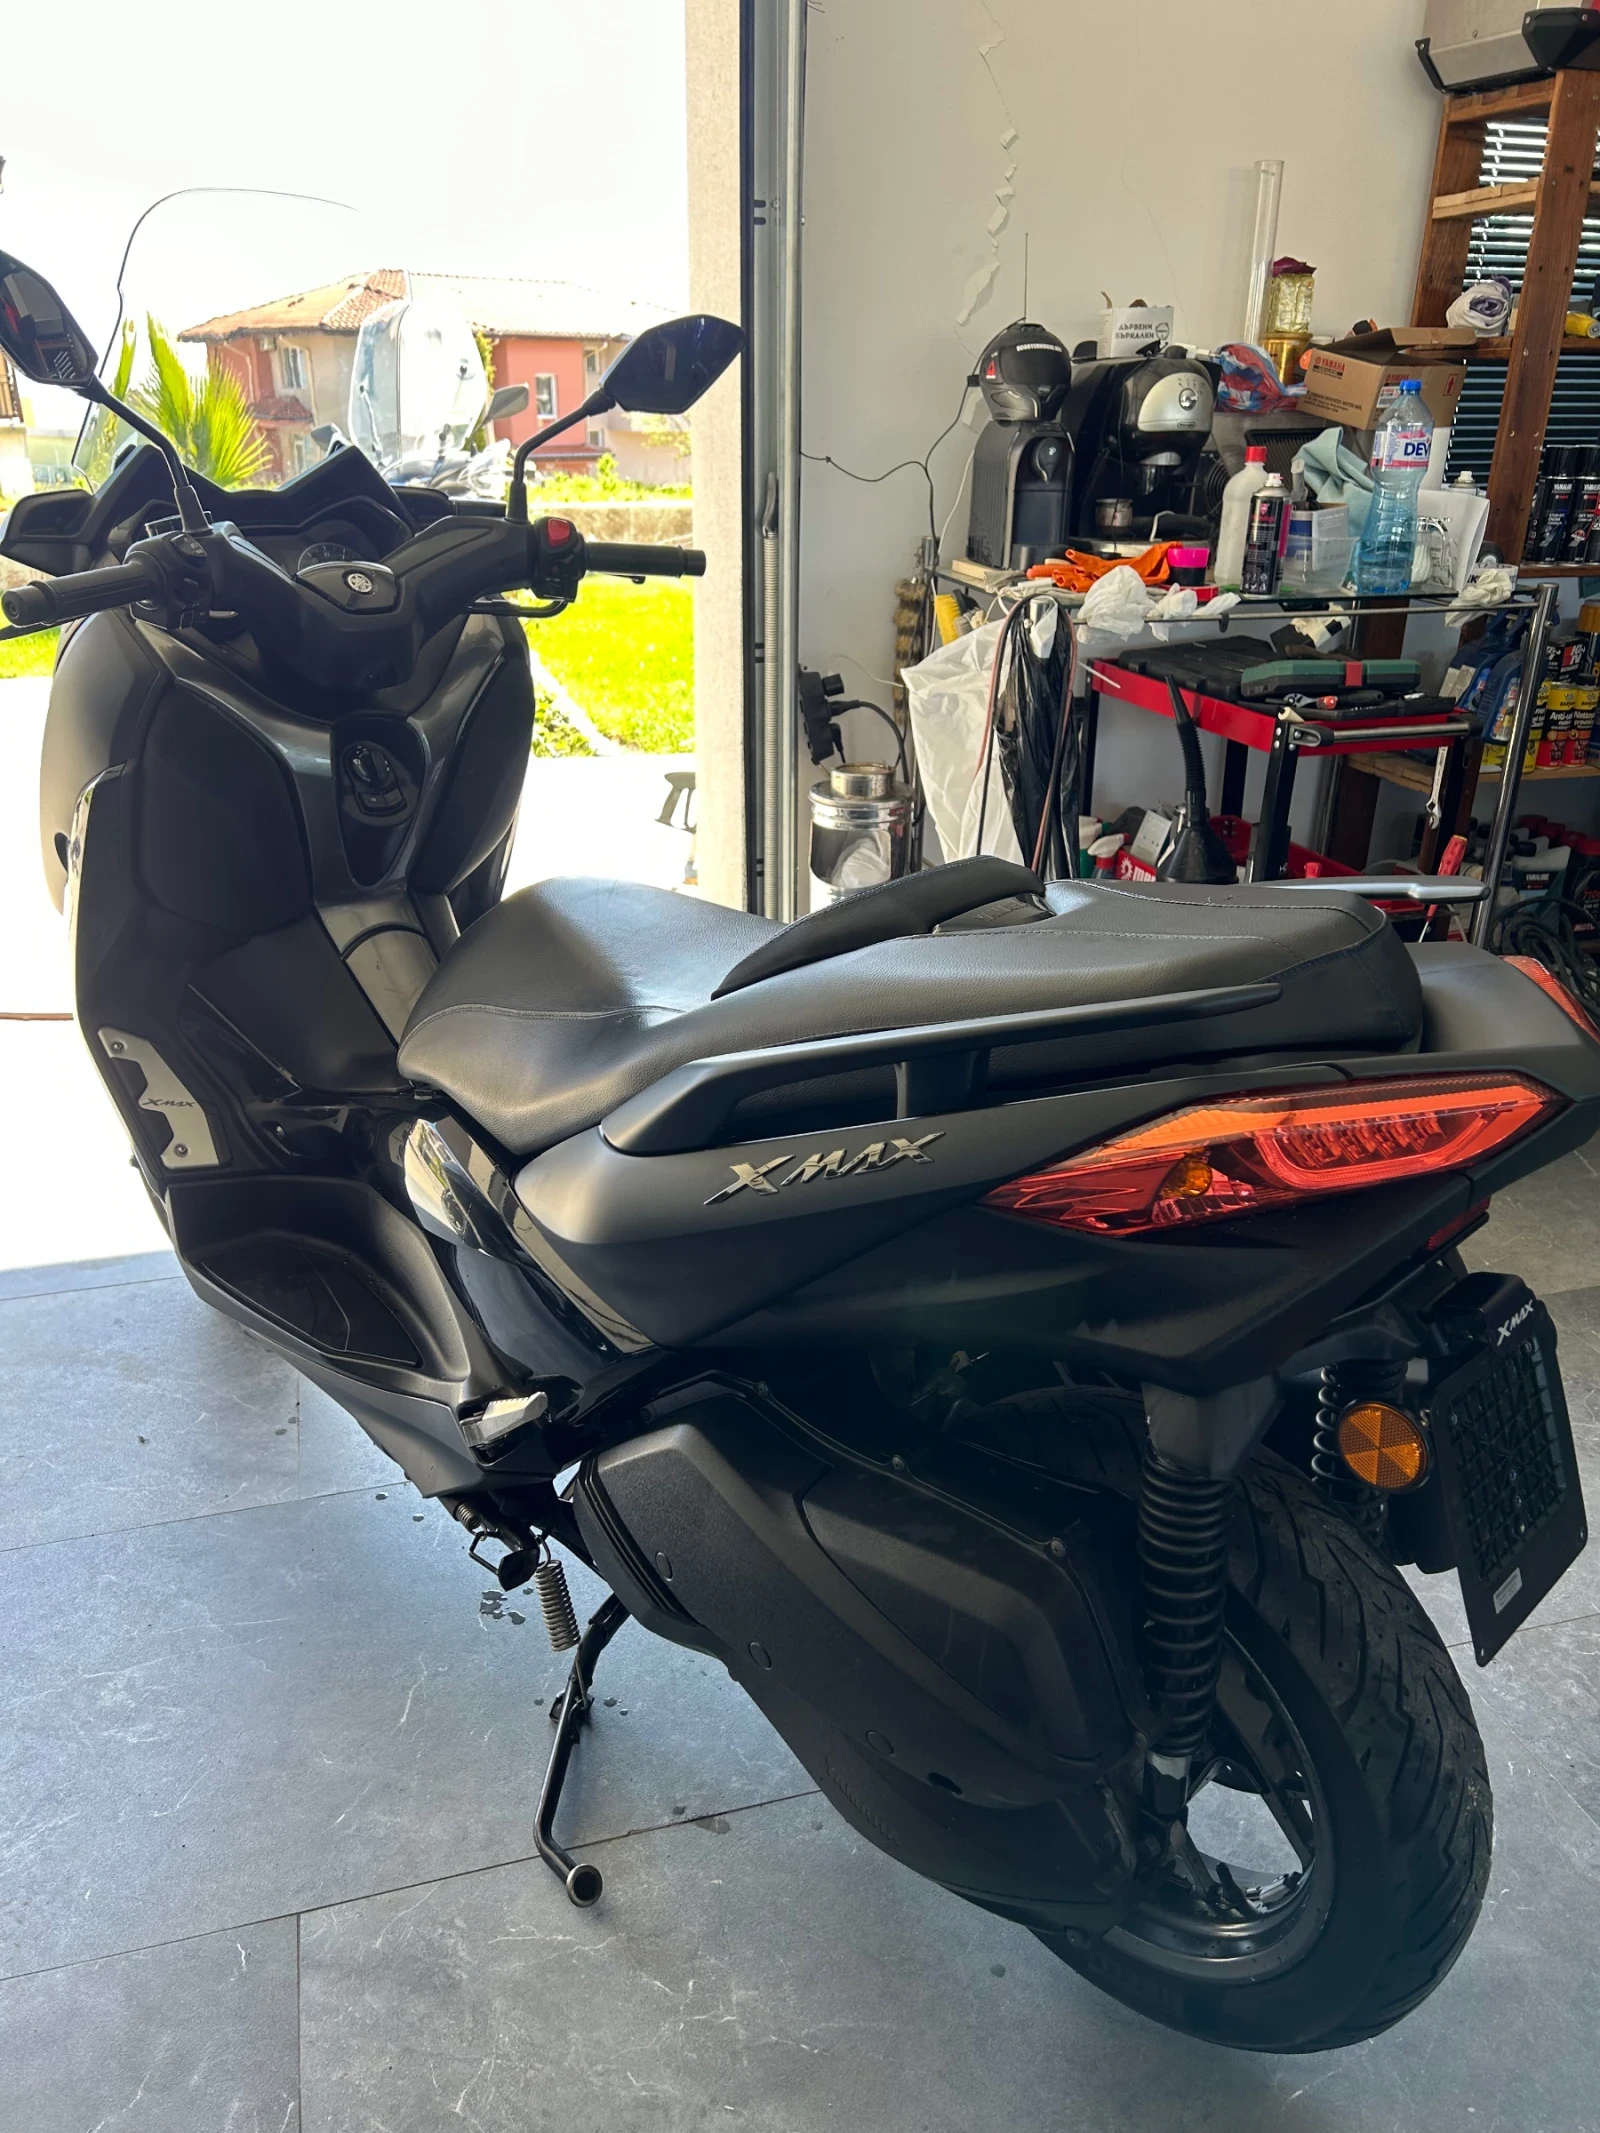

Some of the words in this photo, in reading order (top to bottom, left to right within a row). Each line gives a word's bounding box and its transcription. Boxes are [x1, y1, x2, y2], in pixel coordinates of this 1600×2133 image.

[1118, 322, 1153, 332] ДЪРВЕНИ
[1115, 331, 1155, 340] БЪРКАЛКИ
[1321, 358, 1346, 373] YAMAHA
[142, 1098, 197, 1108] XMAX
[703, 1131, 946, 1205] XMAX
[1497, 1299, 1534, 1347] XMAX
